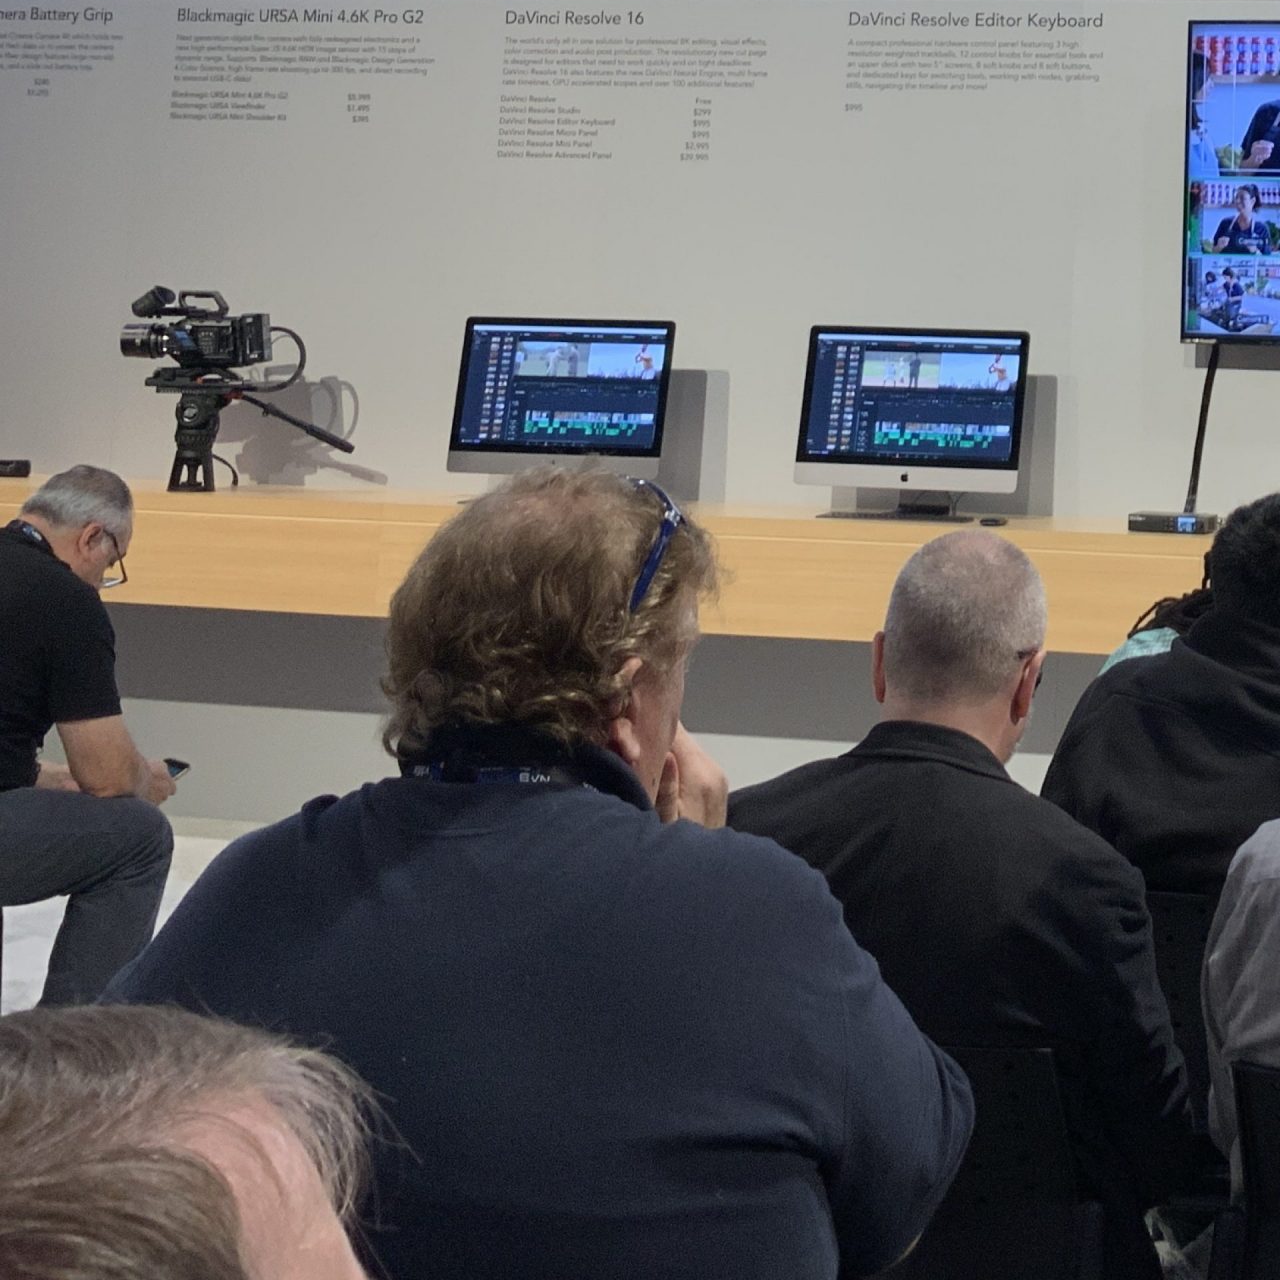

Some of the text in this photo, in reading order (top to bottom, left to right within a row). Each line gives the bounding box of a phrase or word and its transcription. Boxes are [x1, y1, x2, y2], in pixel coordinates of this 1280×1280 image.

[30, 7, 79, 24] Battery
[84, 8, 113, 24] Grip
[178, 8, 423, 25] Blackmagic URSA Mini 4.6K Pro G2
[506, 11, 643, 24] DaVinci Resolve 16
[849, 12, 1102, 31] DaVinci Resolve Editor Keyboard
